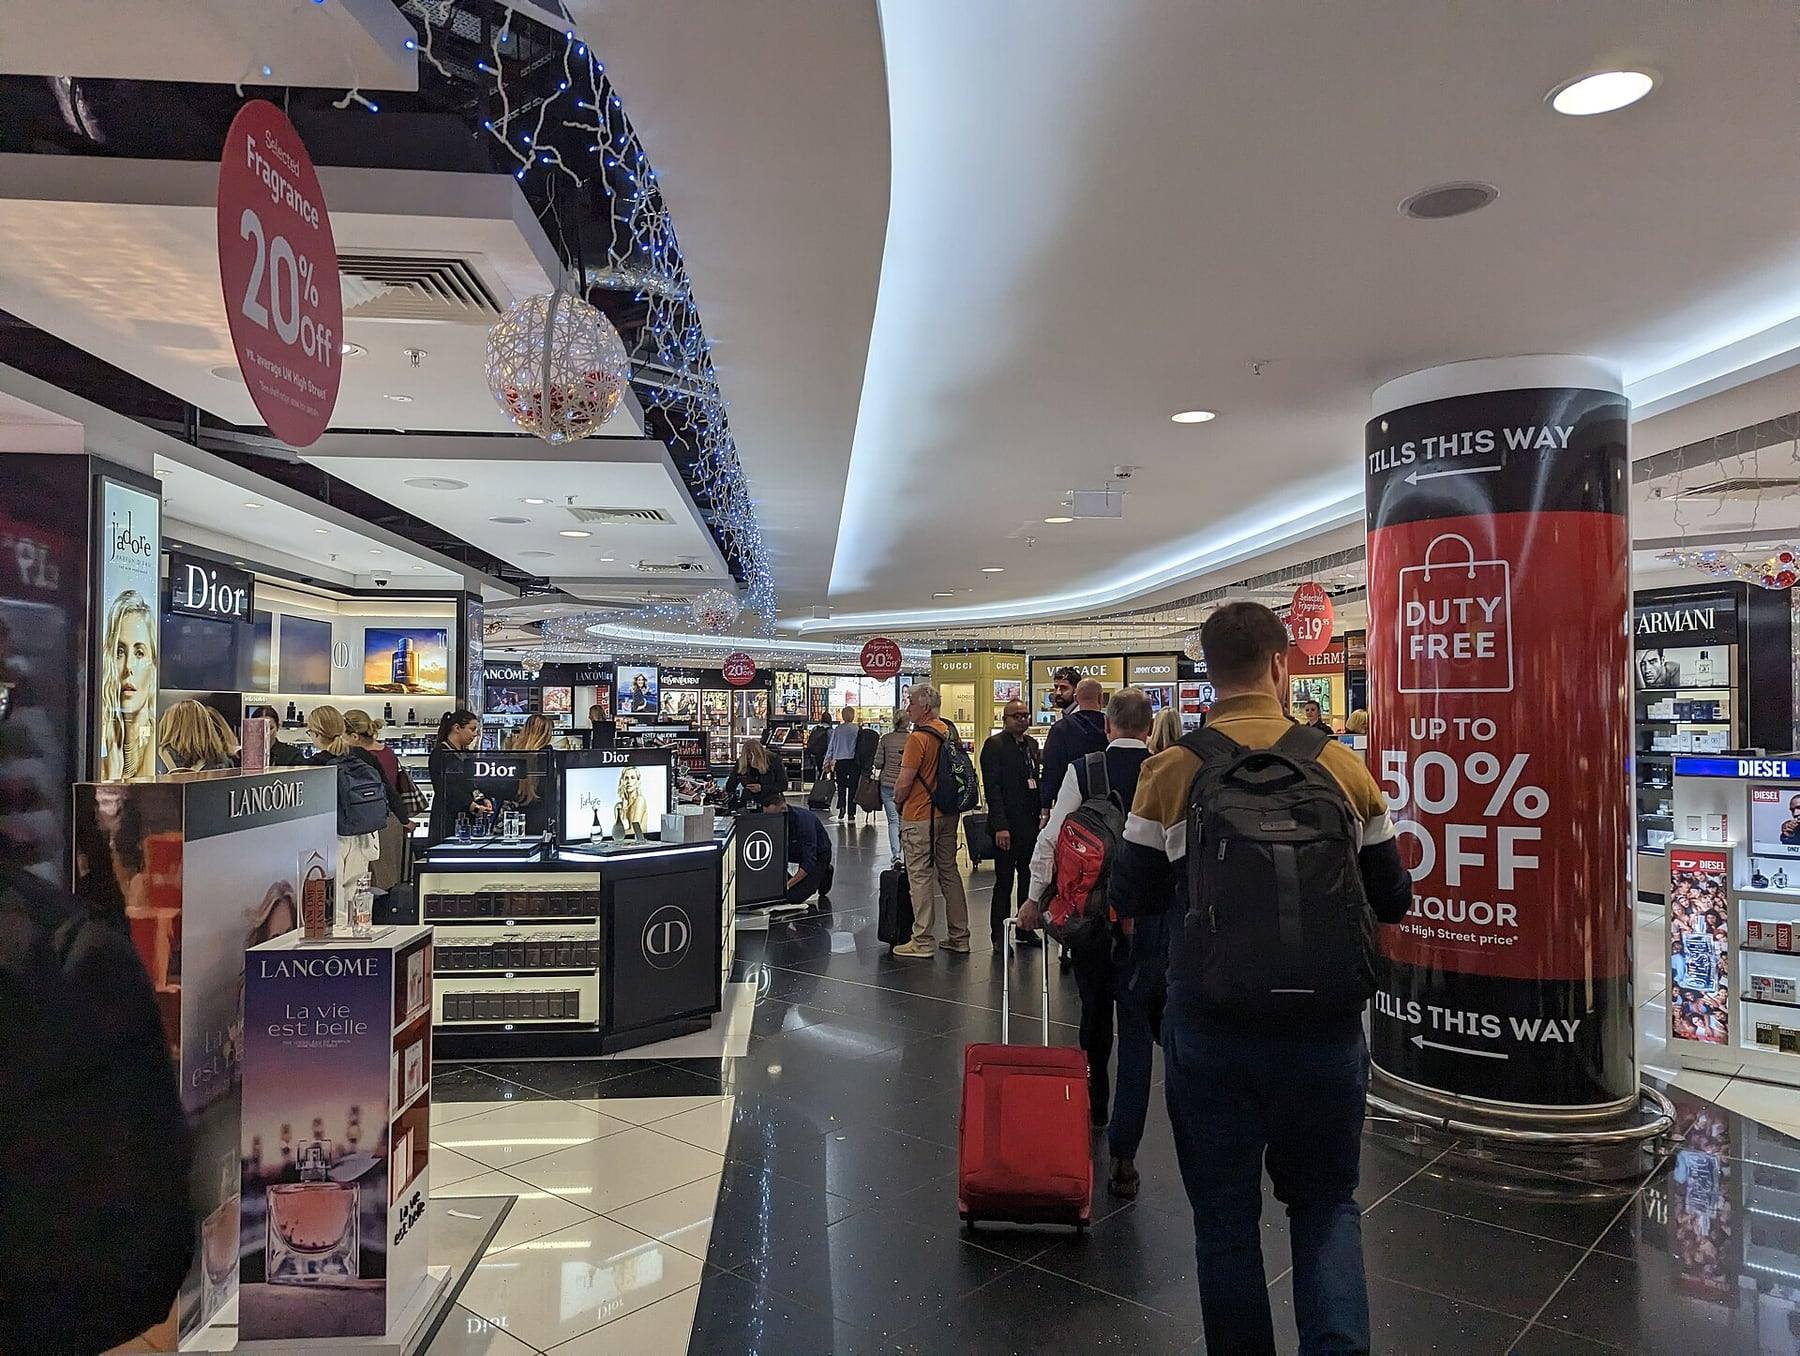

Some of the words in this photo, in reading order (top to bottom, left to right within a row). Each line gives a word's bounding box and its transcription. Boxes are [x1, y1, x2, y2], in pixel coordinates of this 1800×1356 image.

[264, 129, 301, 178] Selected
[247, 134, 320, 230] Fragrance
[240, 208, 319, 345] 20%
[300, 315, 332, 368] Off
[1369, 440, 1417, 475] TILLS
[1421, 429, 1496, 460] THIS
[1501, 425, 1575, 451] WAY
[110, 510, 151, 561] j'adore
[184, 563, 246, 616] Dior
[1405, 596, 1502, 627] DUTY
[1636, 607, 1716, 635] ARMANI
[1409, 631, 1496, 660] FREE
[865, 652, 894, 667] 20%
[942, 662, 972, 670] GUCCI
[996, 662, 1020, 670] GUCCI
[1046, 664, 1107, 677] VSACE
[482, 667, 529, 681] ANCÔME
[1409, 717, 1447, 741] UP
[1453, 717, 1498, 741] TO
[473, 761, 517, 777] Dior
[602, 750, 630, 764] Dior
[1738, 760, 1791, 778] DIESEL
[1380, 750, 1550, 819] 50%
[1753, 790, 1779, 800] DIESEL
[230, 779, 304, 818] LANCÔME
[1391, 819, 1542, 891] OFF
[1699, 859, 1726, 871] DIESEL
[1399, 923, 1410, 933] vs
[1411, 924, 1436, 940] High
[1437, 928, 1477, 943] Street
[260, 954, 379, 979] LANCÔME
[286, 1003, 310, 1020] La
[317, 1002, 351, 1019] vie
[267, 1022, 310, 1037] est
[315, 1019, 369, 1036] belle
[1427, 1005, 1502, 1039] THIS
[1508, 1017, 1581, 1044] WAY
